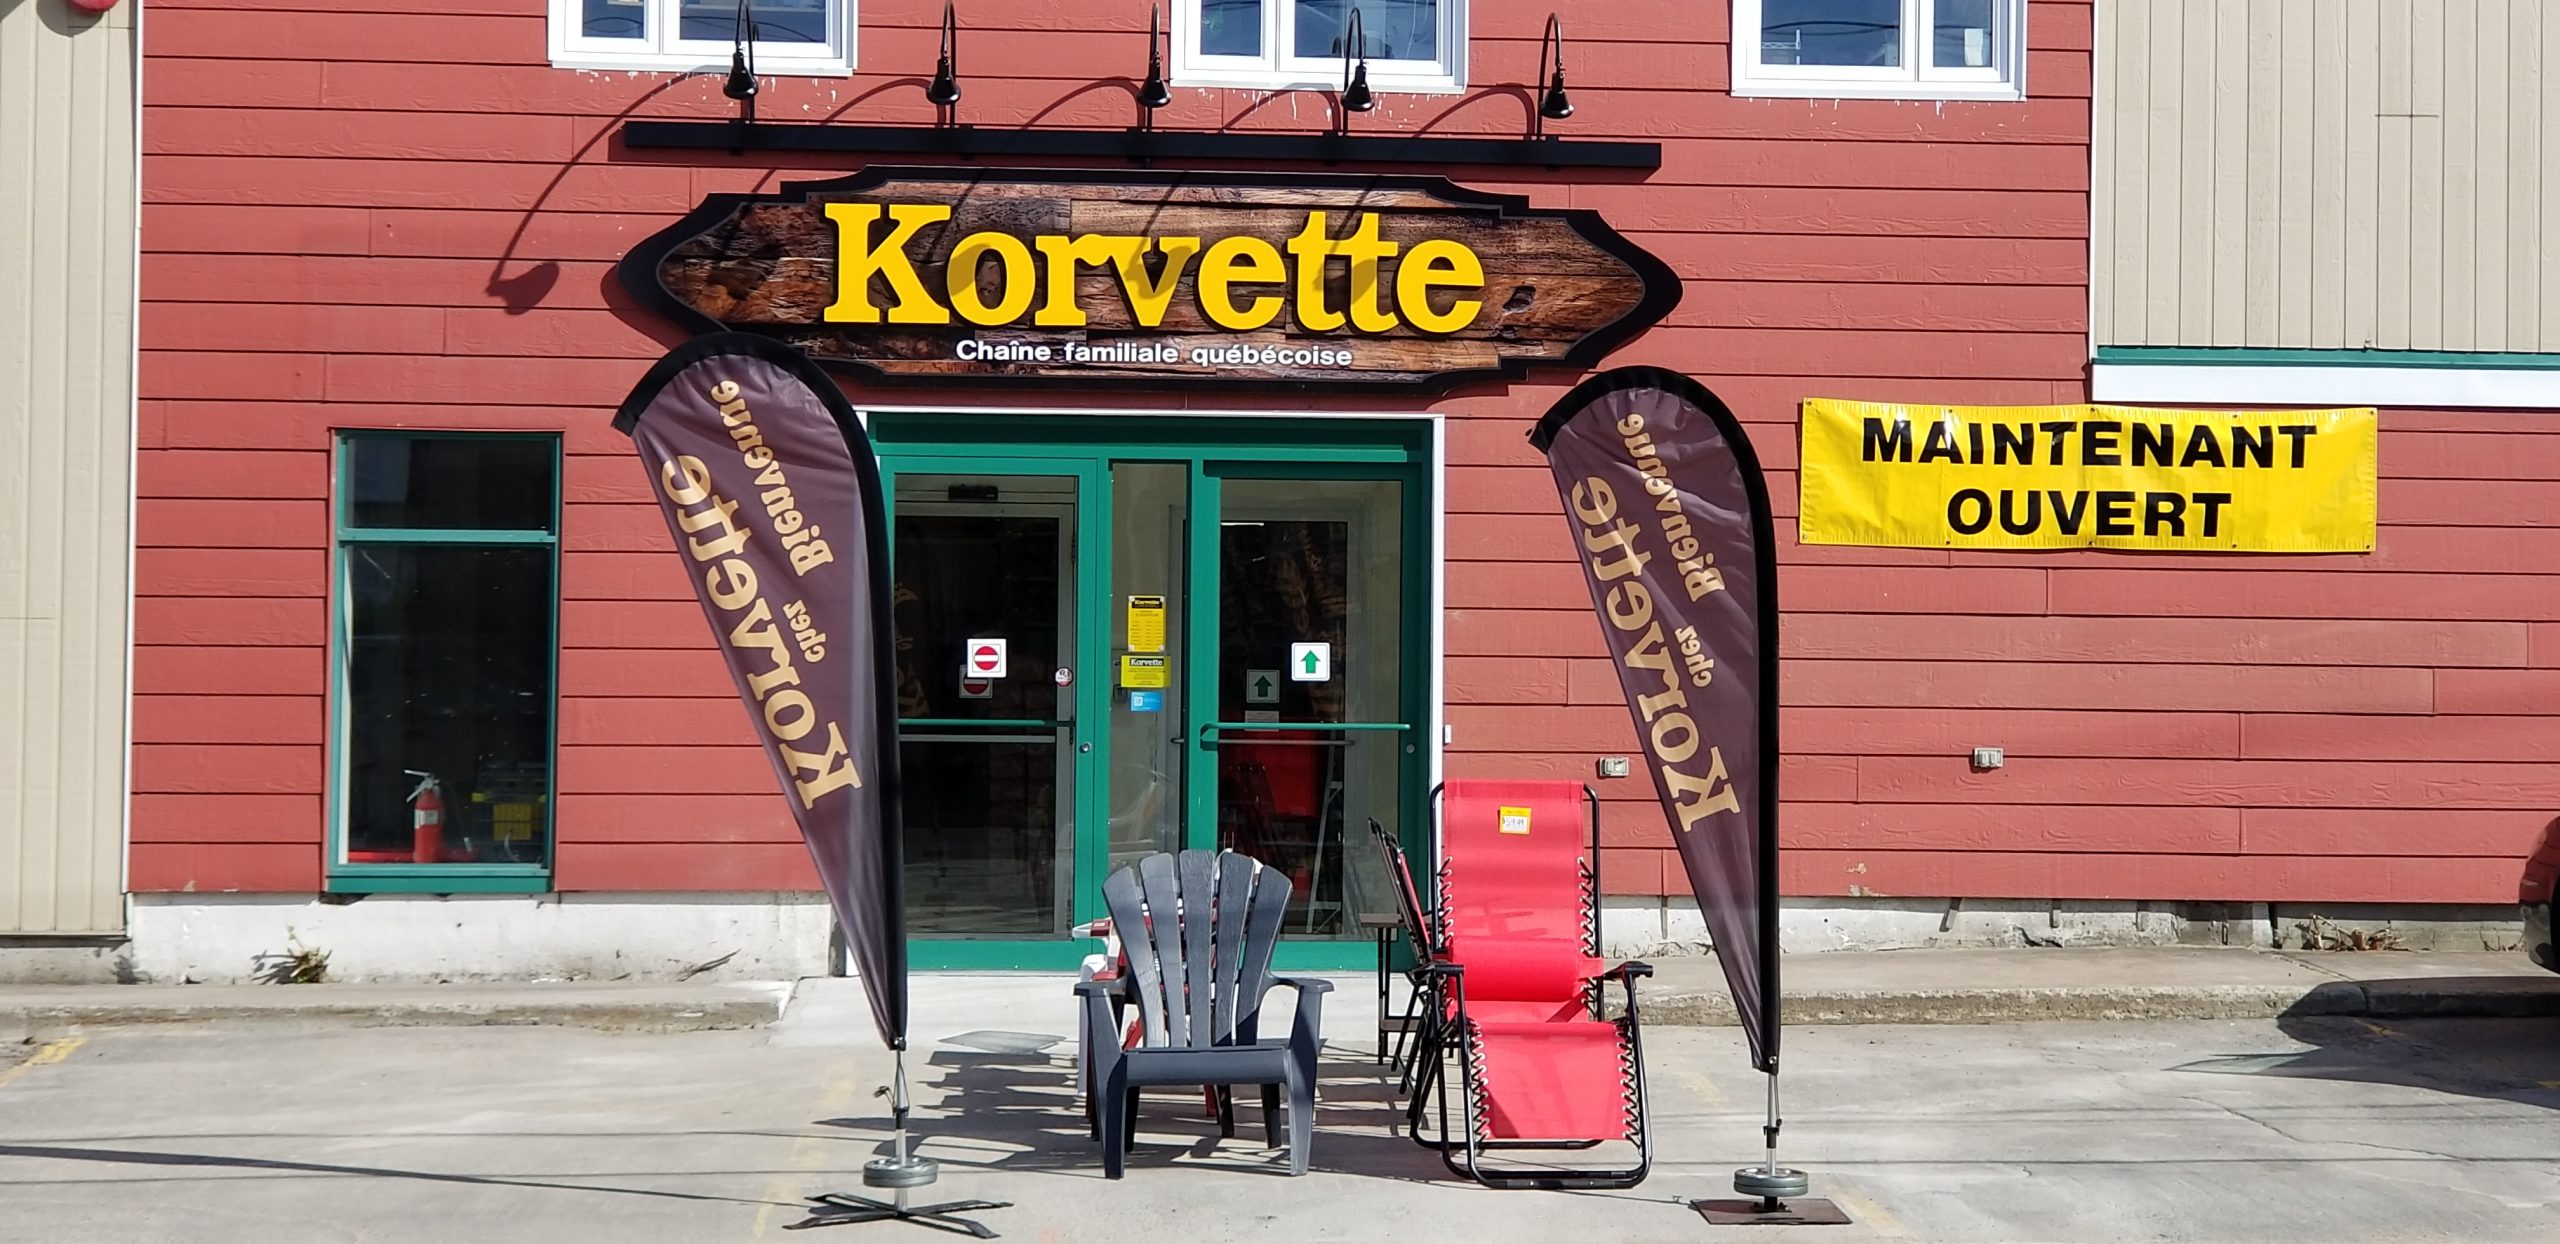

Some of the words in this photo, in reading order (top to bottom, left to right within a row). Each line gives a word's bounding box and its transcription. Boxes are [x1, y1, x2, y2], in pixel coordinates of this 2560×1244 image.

[823, 202, 1486, 334] Korvette
[956, 339, 1052, 362] Chaîne
[1063, 341, 1179, 363] familiale
[1191, 341, 1354, 368] québécoise
[1862, 416, 2317, 468] MAINTENANT
[1947, 488, 2232, 538] OUVERT
[1130, 658, 1163, 666] Korvette
